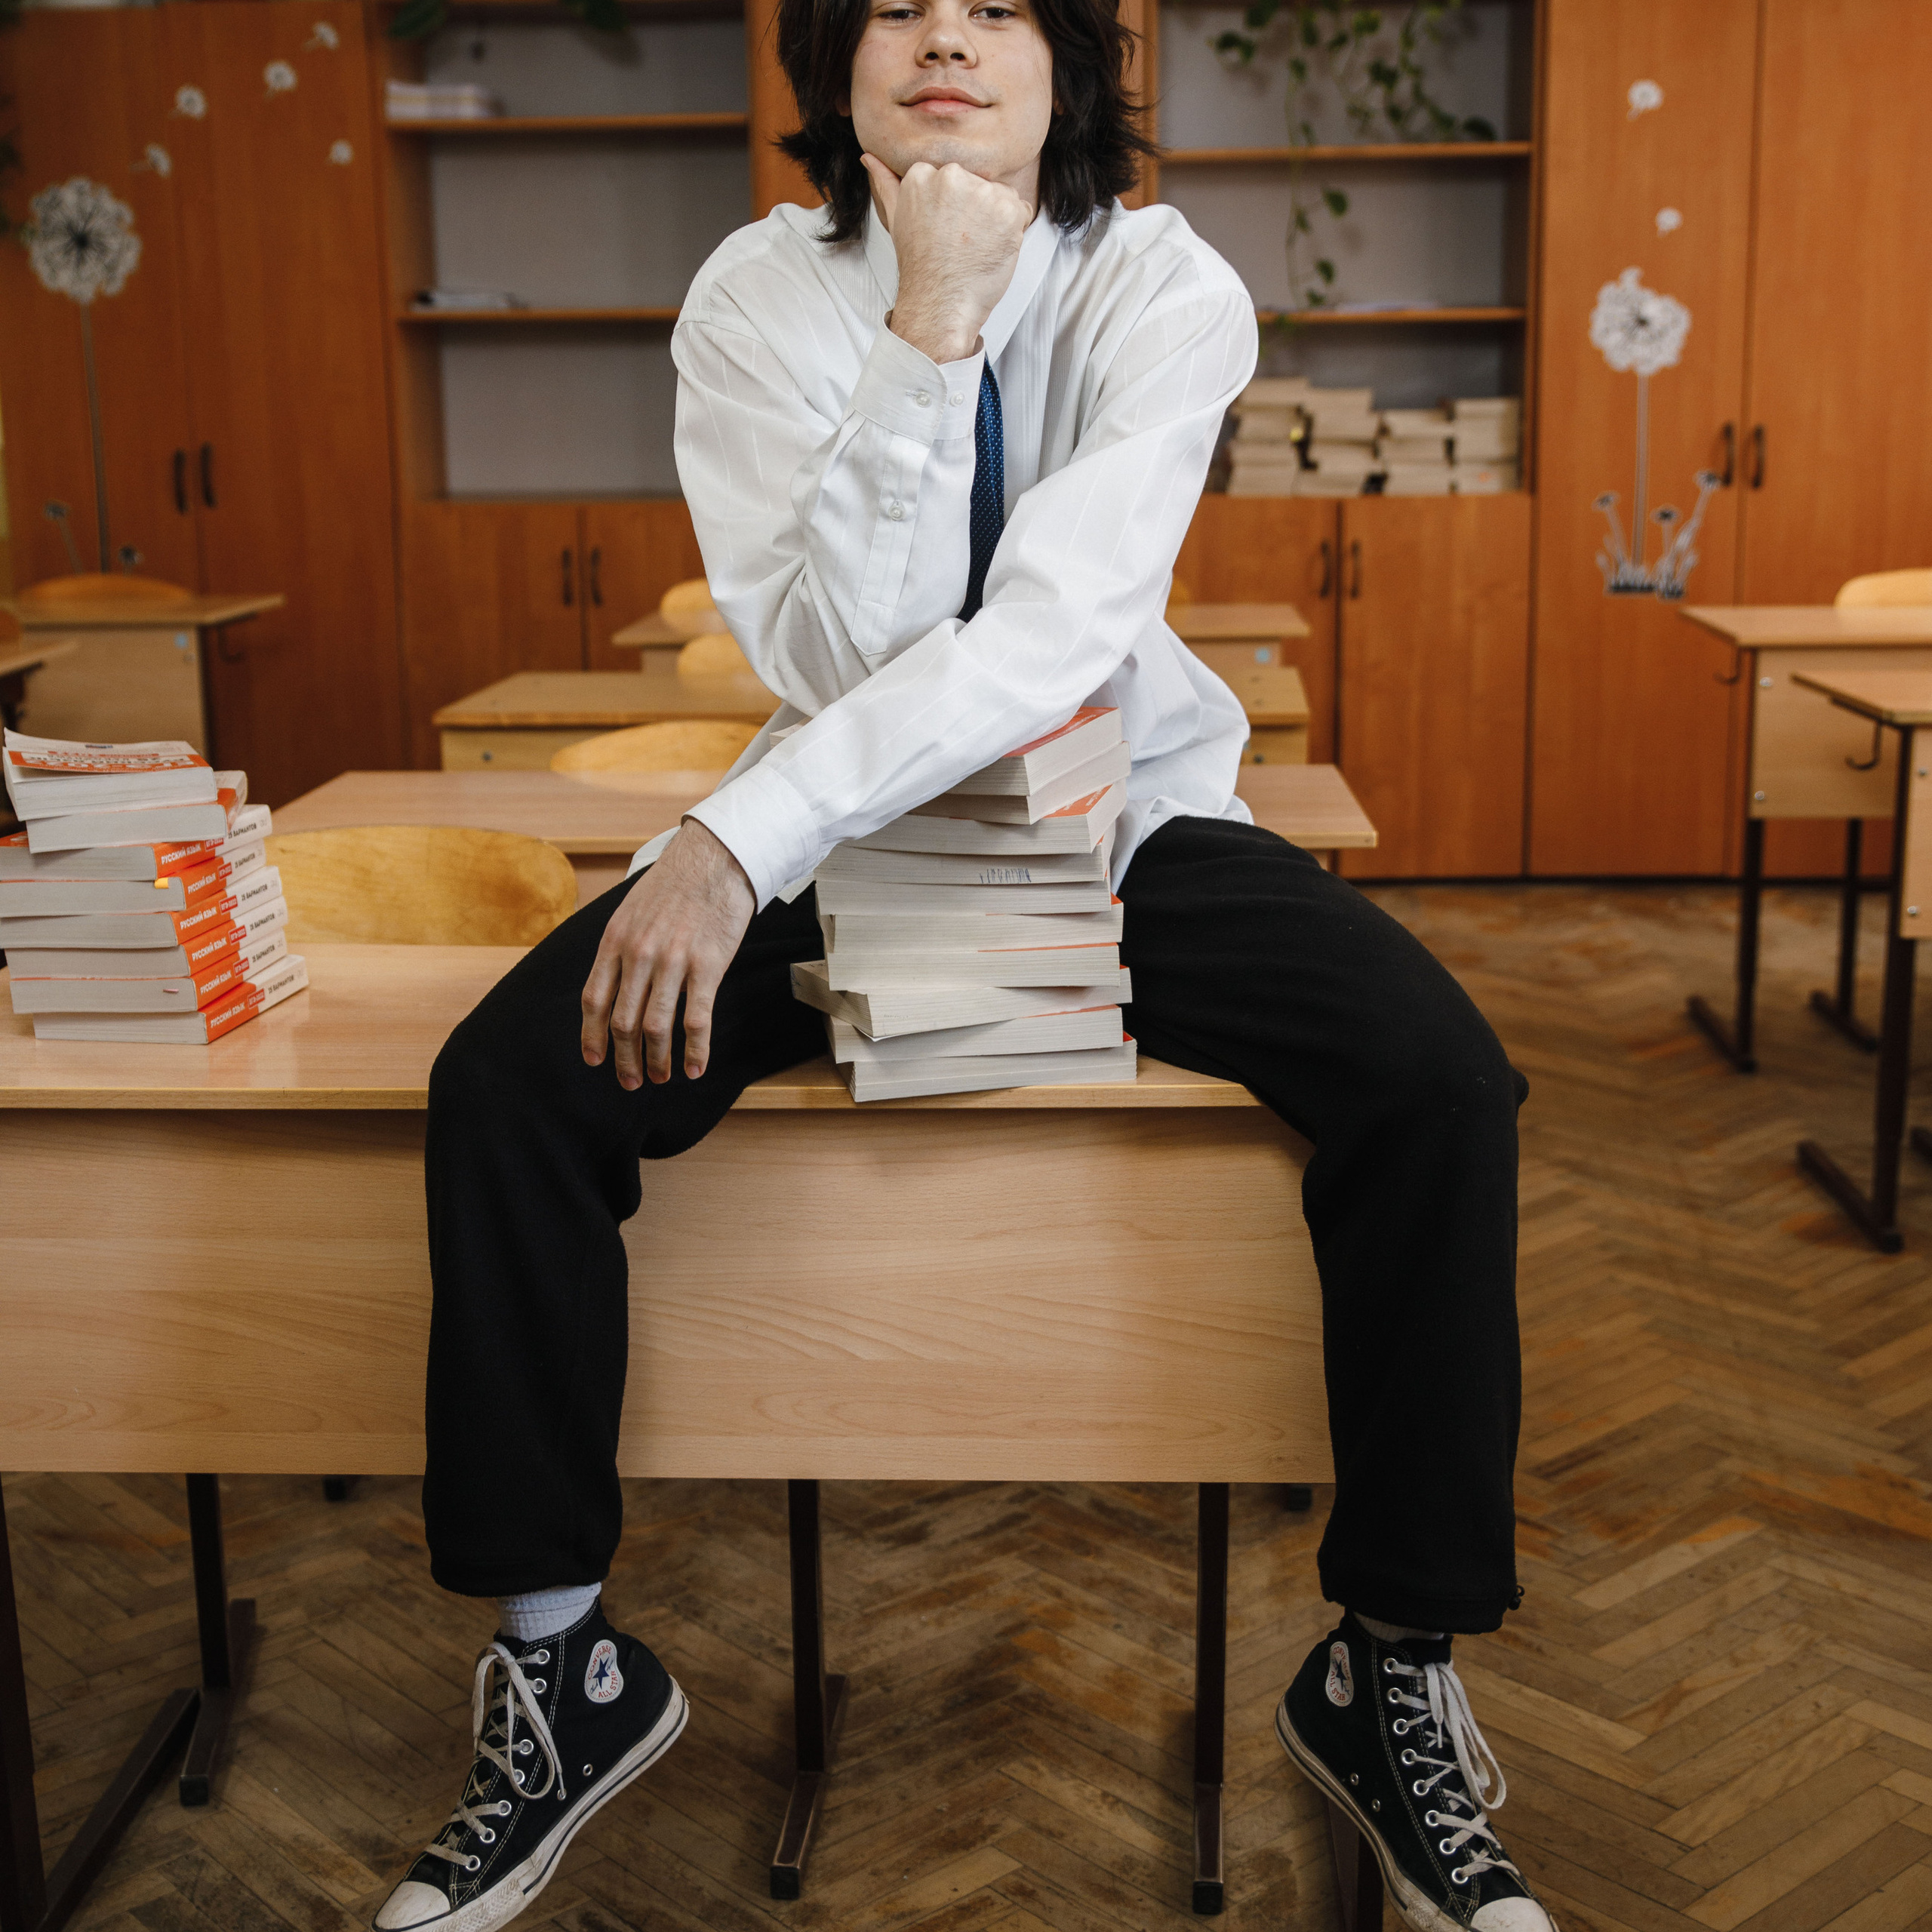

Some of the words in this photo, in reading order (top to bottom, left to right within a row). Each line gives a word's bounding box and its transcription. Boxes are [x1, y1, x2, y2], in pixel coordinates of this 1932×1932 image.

[161, 847, 186, 865] РУССКИЙ
[186, 843, 202, 856] ЯЗЫК
[228, 831, 232, 839] 25
[233, 823, 257, 837] ВАРИАНТОВ
[187, 876, 205, 894] РУССКИЙ
[205, 872, 217, 885] ЯЗЫК
[238, 852, 255, 866] ВАРИАНТОВ
[180, 910, 204, 930] РУССКИЙ
[203, 906, 217, 919] ЯЗЫК
[246, 884, 268, 899] ВАРИАНТОВ
[192, 942, 214, 961] РУССКИЙ
[214, 937, 227, 950] ЯЗЫК
[254, 913, 275, 928] ВАРИАНТОВ
[200, 975, 220, 995] РУССКИЙ
[220, 970, 232, 983] ЯЗЫК
[256, 944, 275, 960] ВАРИАНТОВ
[210, 1008, 232, 1029] РУССКИЙ
[232, 1002, 245, 1016] ЯЗЫК
[272, 974, 294, 992] ВАРИАНТОВ
[588, 1644, 612, 1680] CONVERSE
[610, 1670, 618, 1690] STAR
[1333, 1646, 1350, 1681] CONV
[1331, 1687, 1346, 1701] STAR
